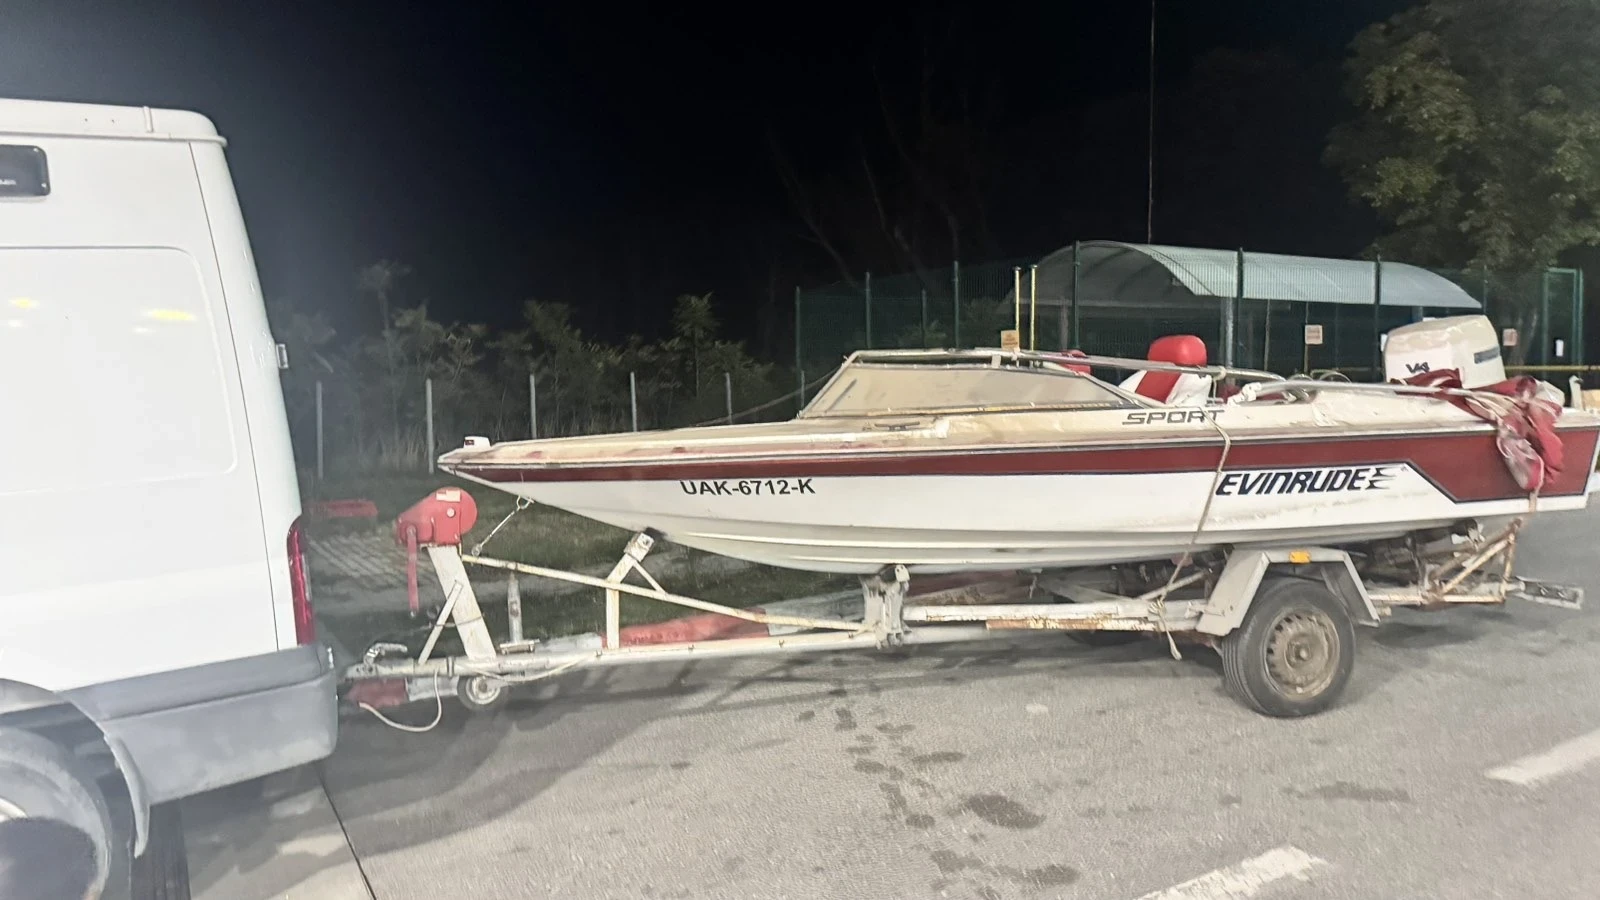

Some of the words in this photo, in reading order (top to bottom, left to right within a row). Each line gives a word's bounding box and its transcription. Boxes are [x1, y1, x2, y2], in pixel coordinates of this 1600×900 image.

[1122, 409, 1225, 425] SPORT
[679, 478, 816, 495] UAK-6712-K
[1216, 468, 1371, 496] EVINRUDE
